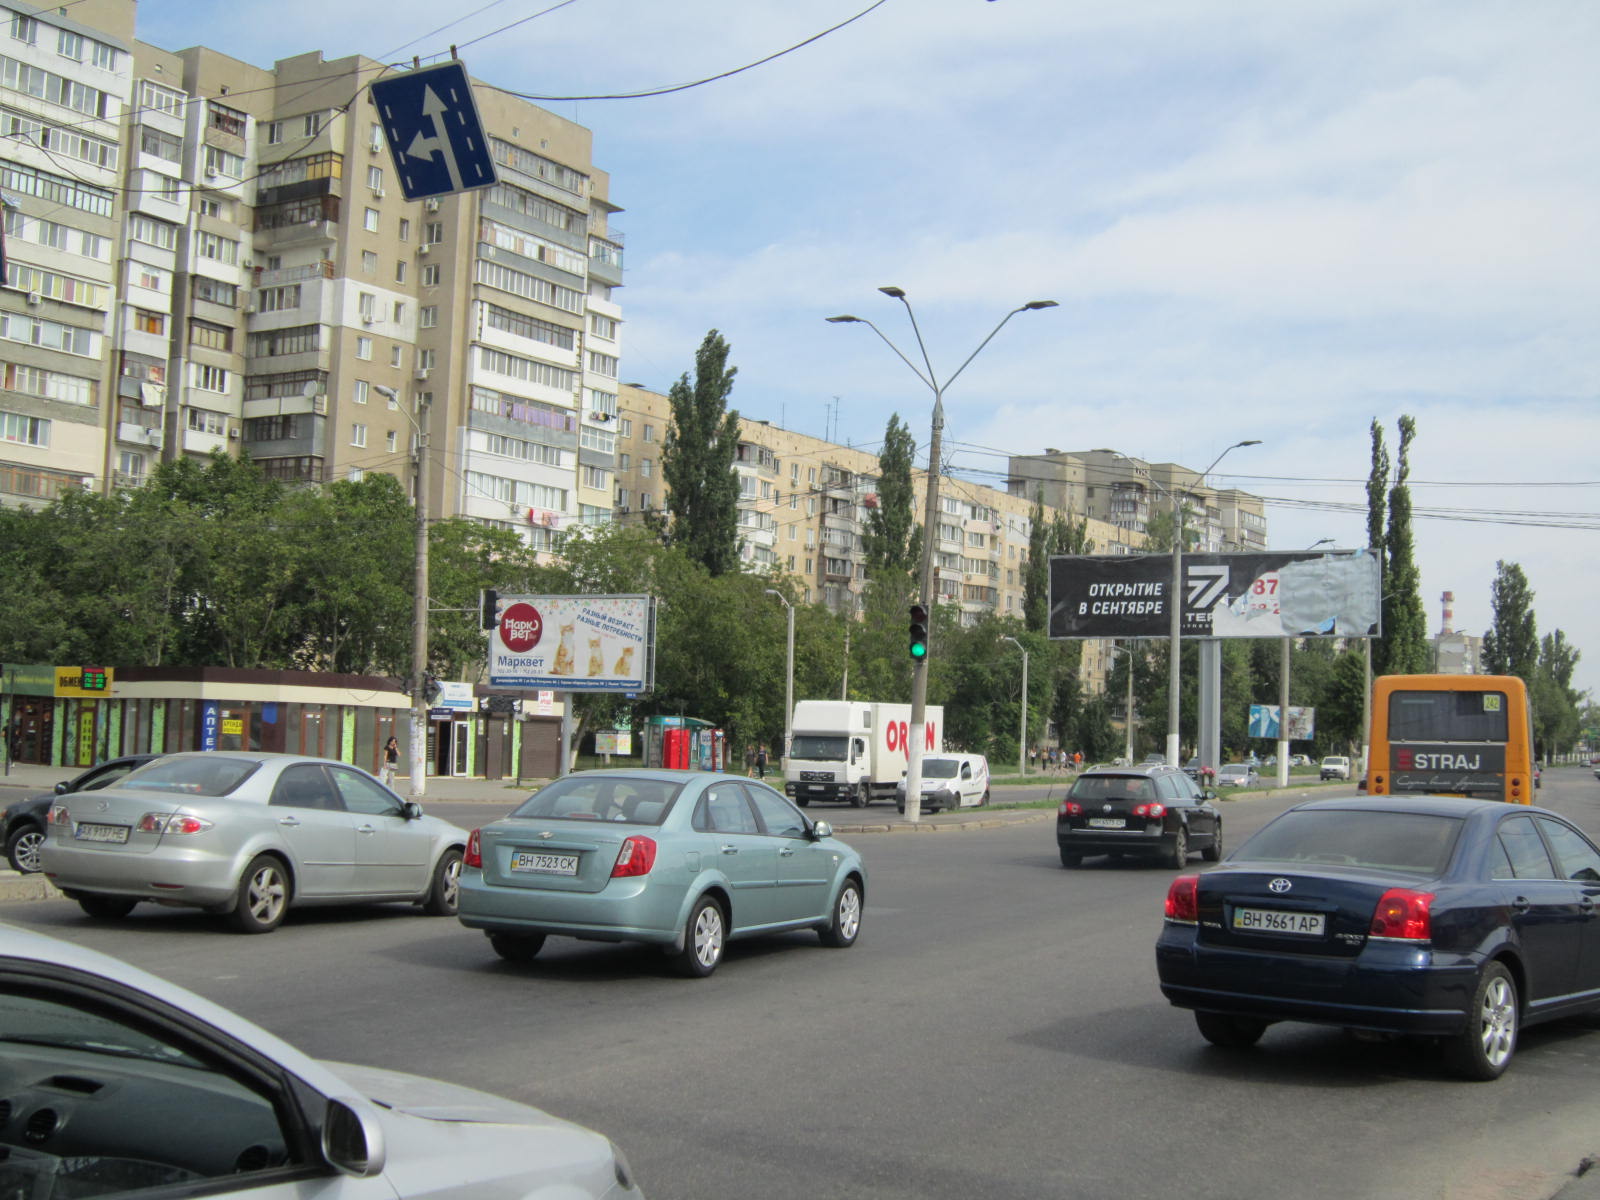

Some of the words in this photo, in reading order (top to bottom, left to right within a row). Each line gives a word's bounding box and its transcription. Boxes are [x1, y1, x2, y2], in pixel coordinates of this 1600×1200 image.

[1089, 582, 1163, 597] ОТКРЫТИЕ
[1078, 601, 1088, 615] В
[1091, 601, 1163, 615] СЕНТЯБРЕ
[582, 607, 608, 621] РАЗНЫЙ
[607, 617, 635, 631] ВОЗРАСТ
[576, 614, 601, 628] РАЗНЫЕ
[601, 623, 643, 642] ПОТРЕБНОСТИ
[497, 655, 544, 669] Марквет
[1415, 753, 1481, 770] STRAJ
[519, 854, 534, 867] BH
[535, 856, 559, 869] 7523
[560, 858, 576, 870] CK
[1243, 911, 1262, 927] BH
[1265, 913, 1297, 930] 9661
[1298, 916, 1320, 932] AP
